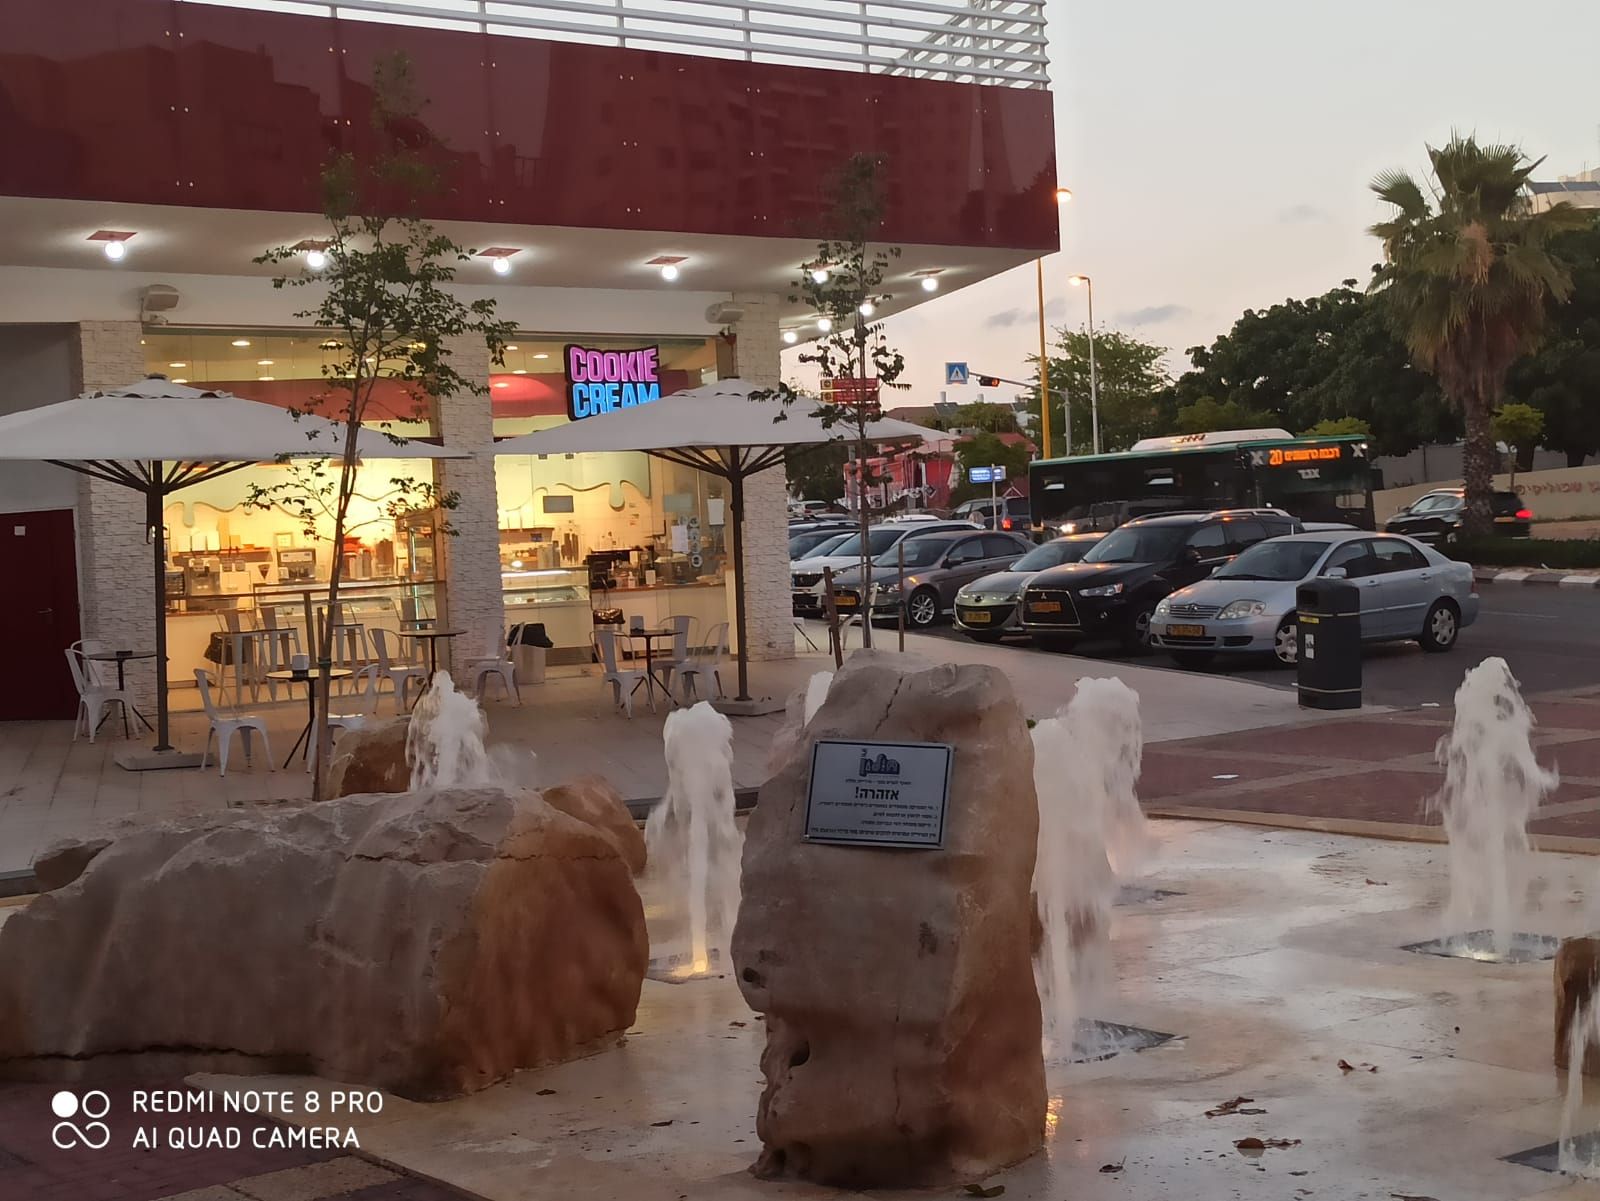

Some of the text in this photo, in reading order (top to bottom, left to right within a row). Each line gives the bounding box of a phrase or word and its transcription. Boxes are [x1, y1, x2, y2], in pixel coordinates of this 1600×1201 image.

[569, 346, 658, 382] COOKIE
[572, 383, 660, 418] CREAM
[1269, 449, 1283, 465] 20
[855, 786, 900, 800] אזהרה!
